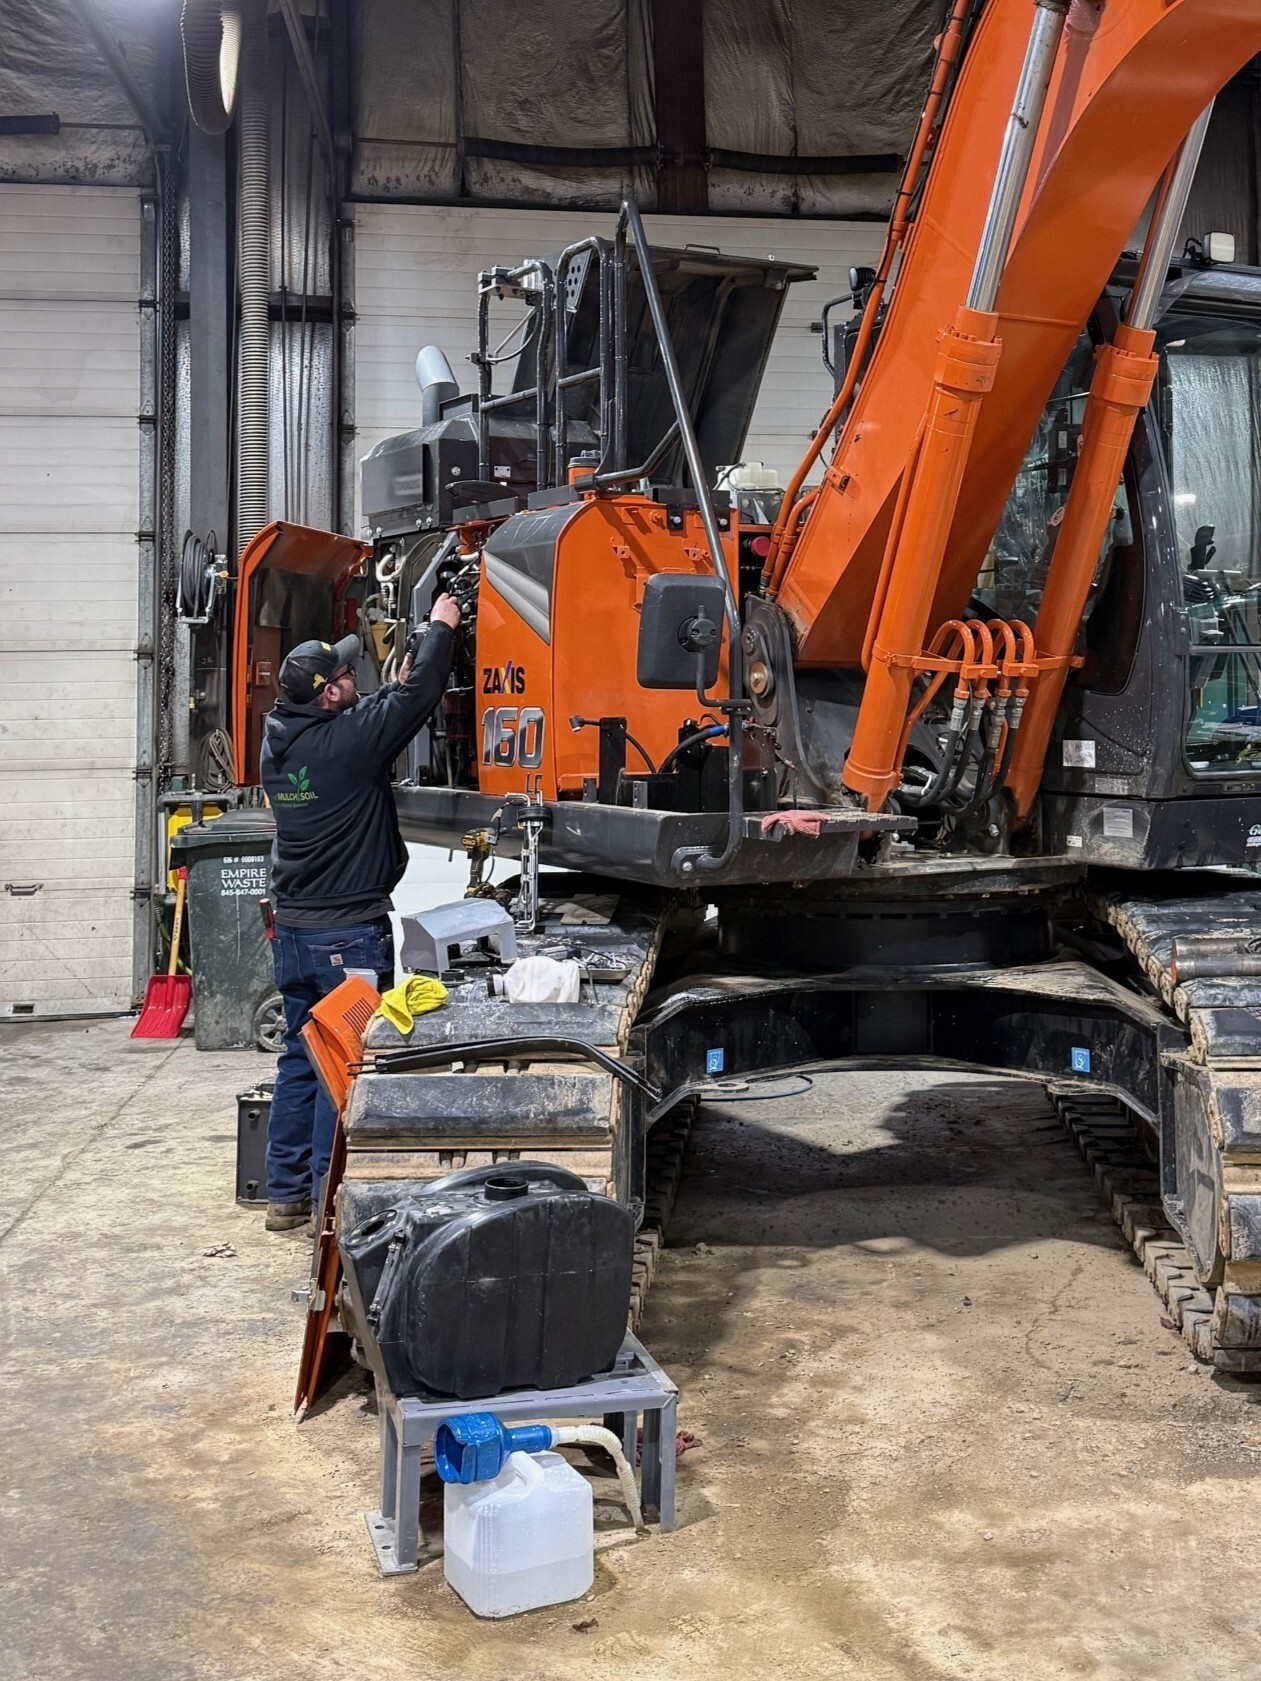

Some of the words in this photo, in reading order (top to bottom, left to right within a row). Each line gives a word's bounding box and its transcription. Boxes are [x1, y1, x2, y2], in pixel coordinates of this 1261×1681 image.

[482, 660, 526, 694] ZAXIS
[481, 706, 546, 769] 160
[220, 867, 267, 879] EMPIRE
[221, 877, 267, 889] WASTE
